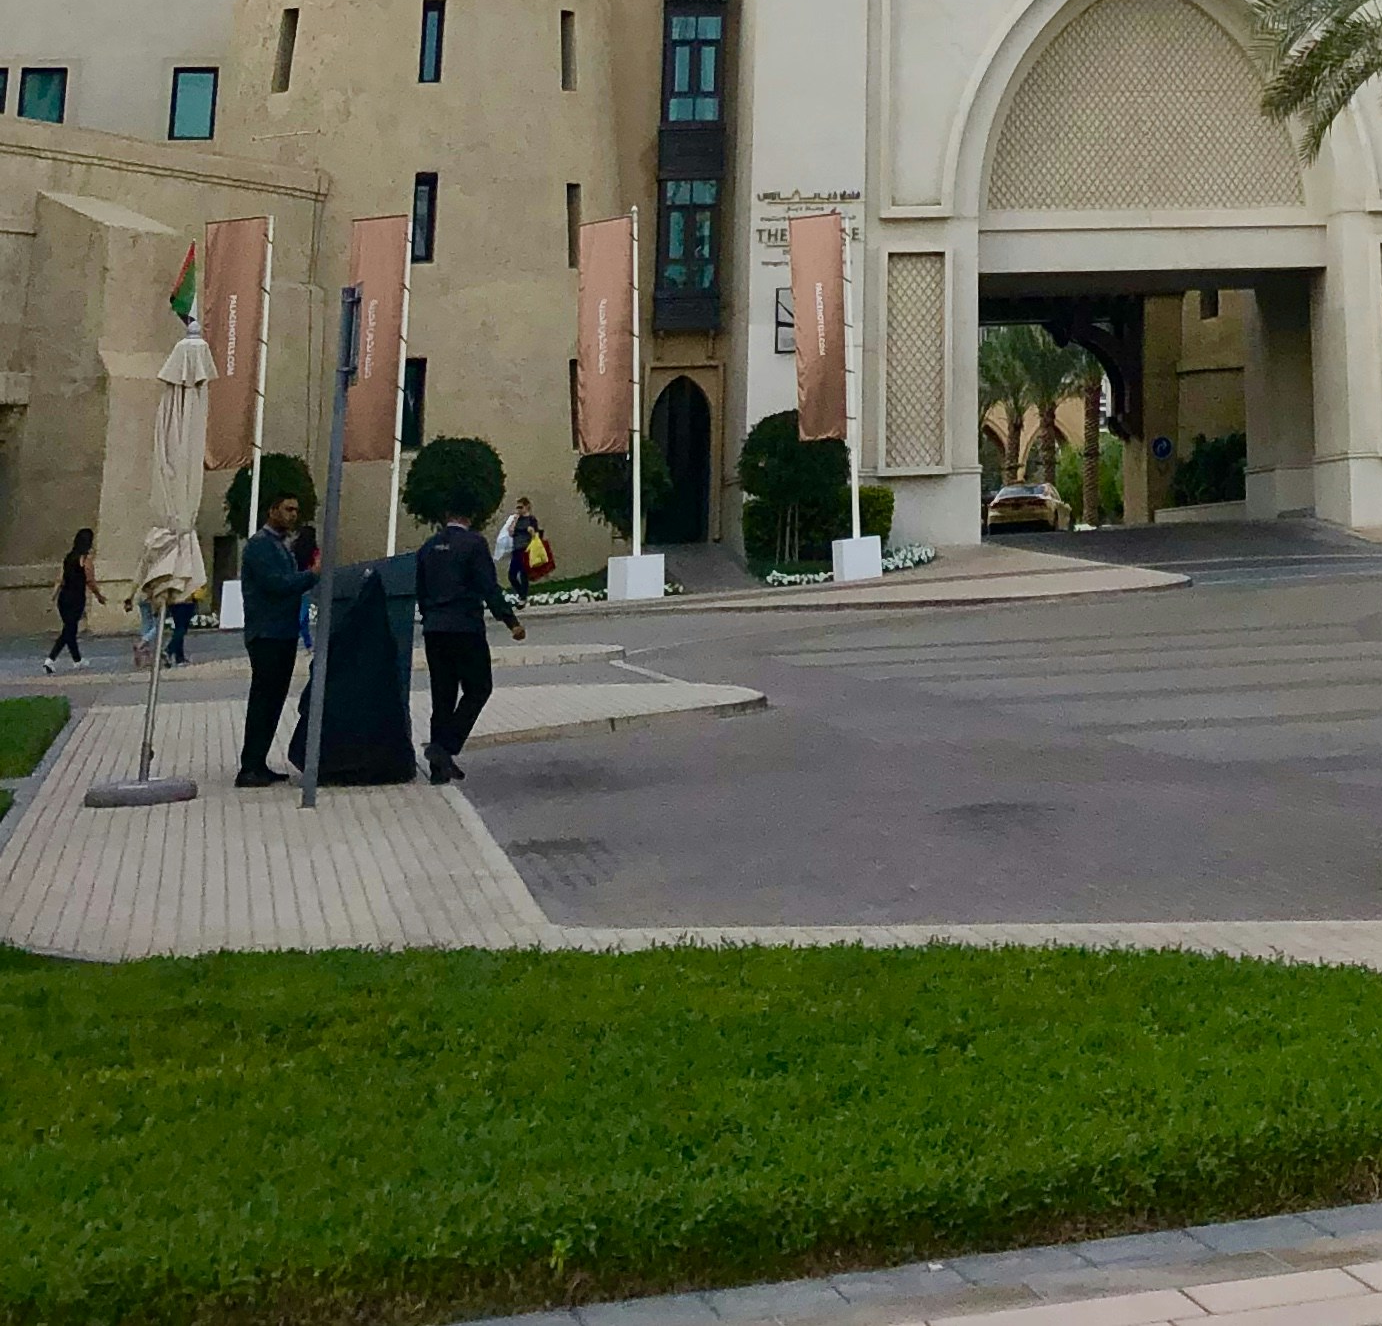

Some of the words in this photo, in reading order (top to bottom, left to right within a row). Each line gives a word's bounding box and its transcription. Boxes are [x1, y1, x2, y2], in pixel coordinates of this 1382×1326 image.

[756, 228, 788, 243] THE
[226, 294, 238, 376] PALACEHOTELS.COM
[815, 282, 826, 356] PALACEHOTELS.COM
